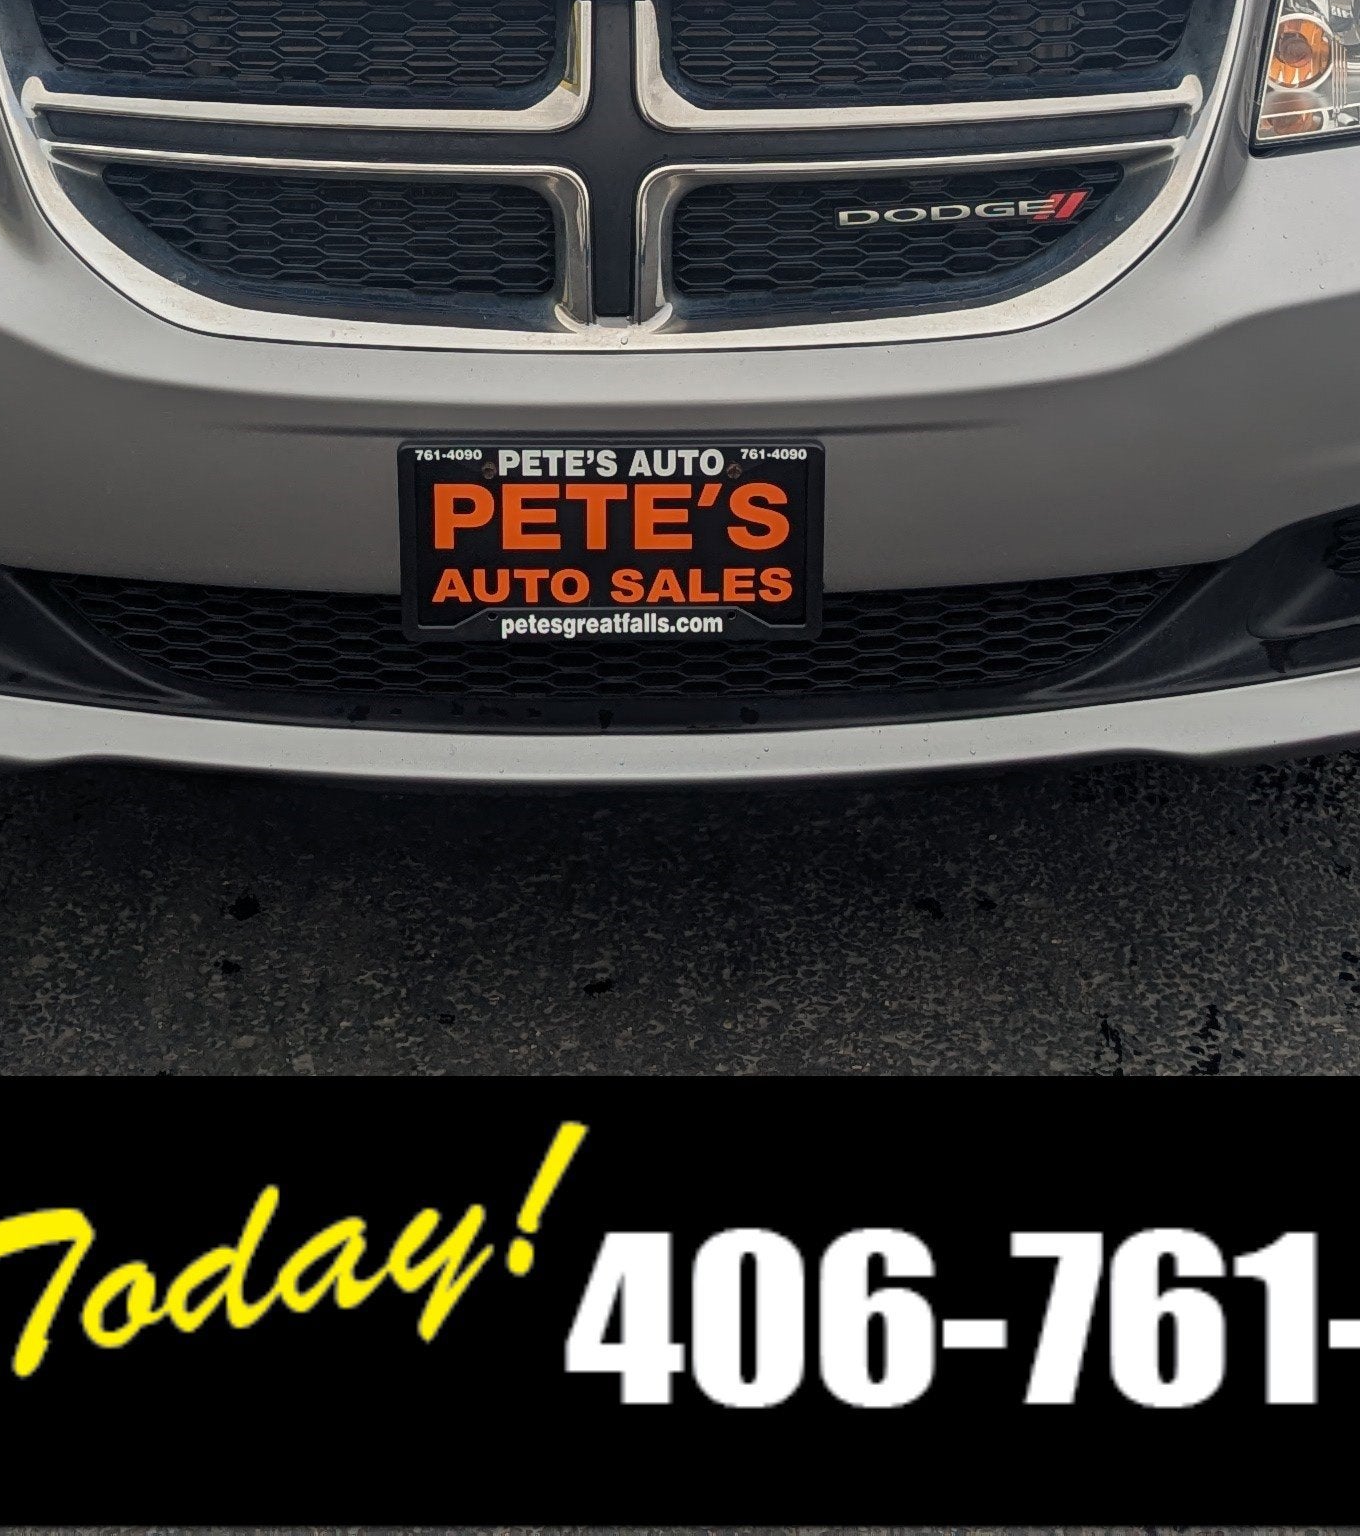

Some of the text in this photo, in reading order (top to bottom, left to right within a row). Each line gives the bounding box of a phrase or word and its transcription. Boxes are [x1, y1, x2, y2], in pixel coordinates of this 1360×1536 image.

[839, 198, 1055, 226] DODGE
[498, 449, 725, 478] PETE'S AUTO
[433, 482, 790, 550] PETE'S
[432, 567, 793, 604] AUTO SALES
[501, 612, 723, 640] petesgreatfalls.com
